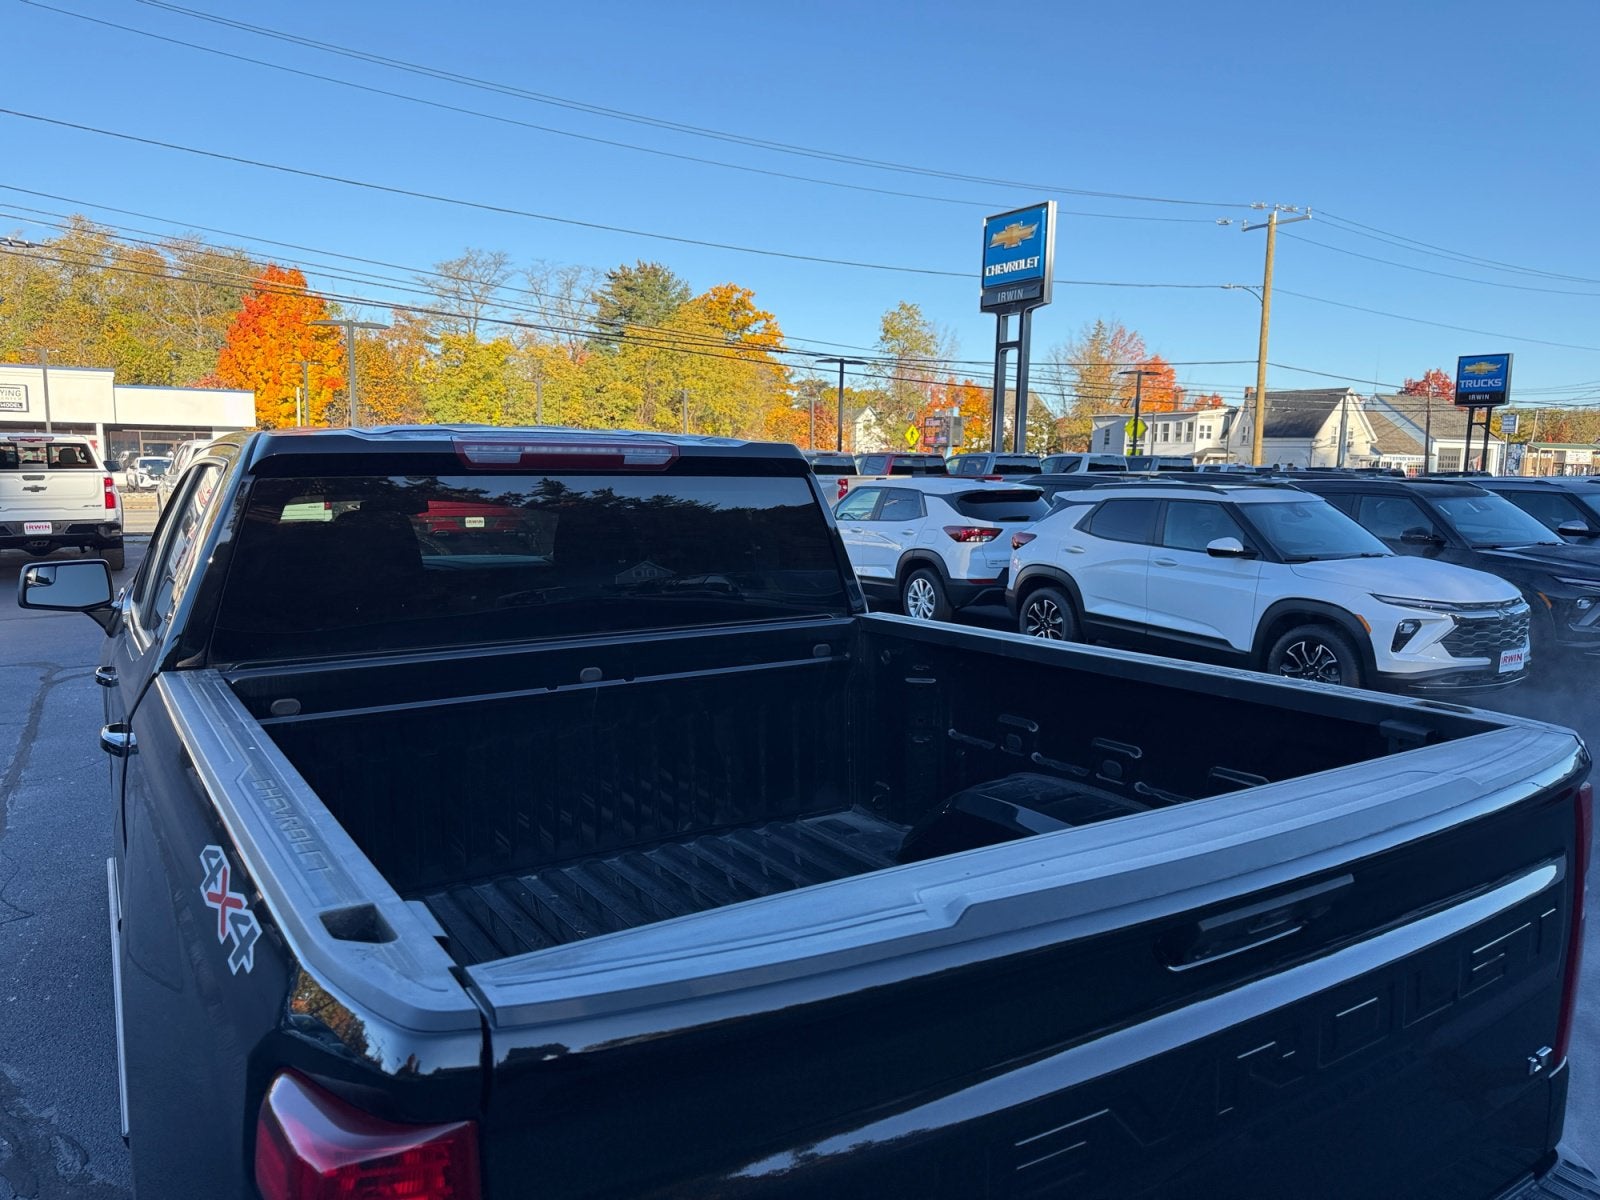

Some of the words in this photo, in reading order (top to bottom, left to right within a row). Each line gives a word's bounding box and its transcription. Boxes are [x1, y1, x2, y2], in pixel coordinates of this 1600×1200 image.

[985, 256, 1039, 277] CHEVROLET
[997, 288, 1024, 303] IRWIN
[1460, 378, 1502, 388] TRUCKS
[1468, 393, 1490, 401] IRWIN
[250, 778, 330, 873] CHEVROLET
